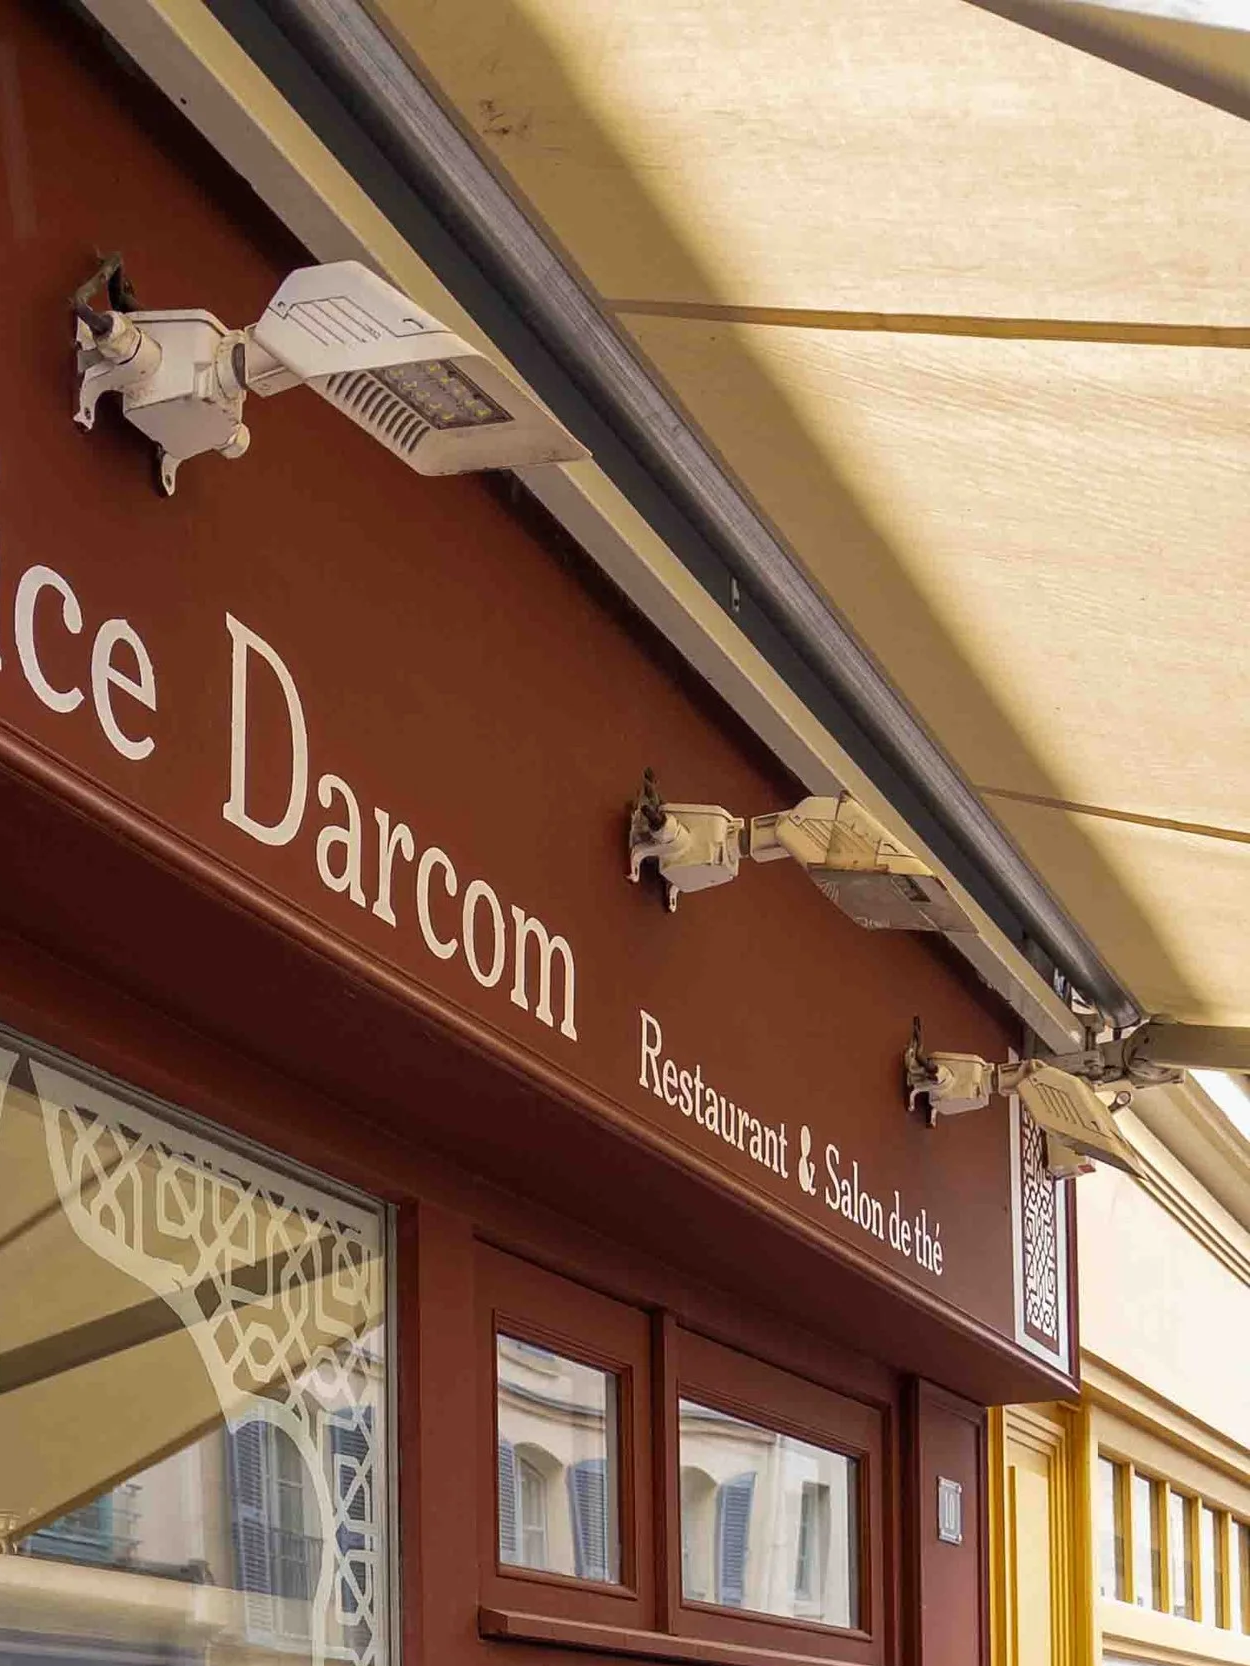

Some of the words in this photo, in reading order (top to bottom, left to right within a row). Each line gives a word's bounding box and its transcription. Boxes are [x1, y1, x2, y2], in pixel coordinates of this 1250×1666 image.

[222, 611, 578, 1042] Darcom
[639, 1009, 788, 1180] Restaurant
[798, 1124, 817, 1196] &
[825, 1143, 884, 1241] Salon
[888, 1190, 911, 1257] de
[914, 1209, 944, 1276] thé
